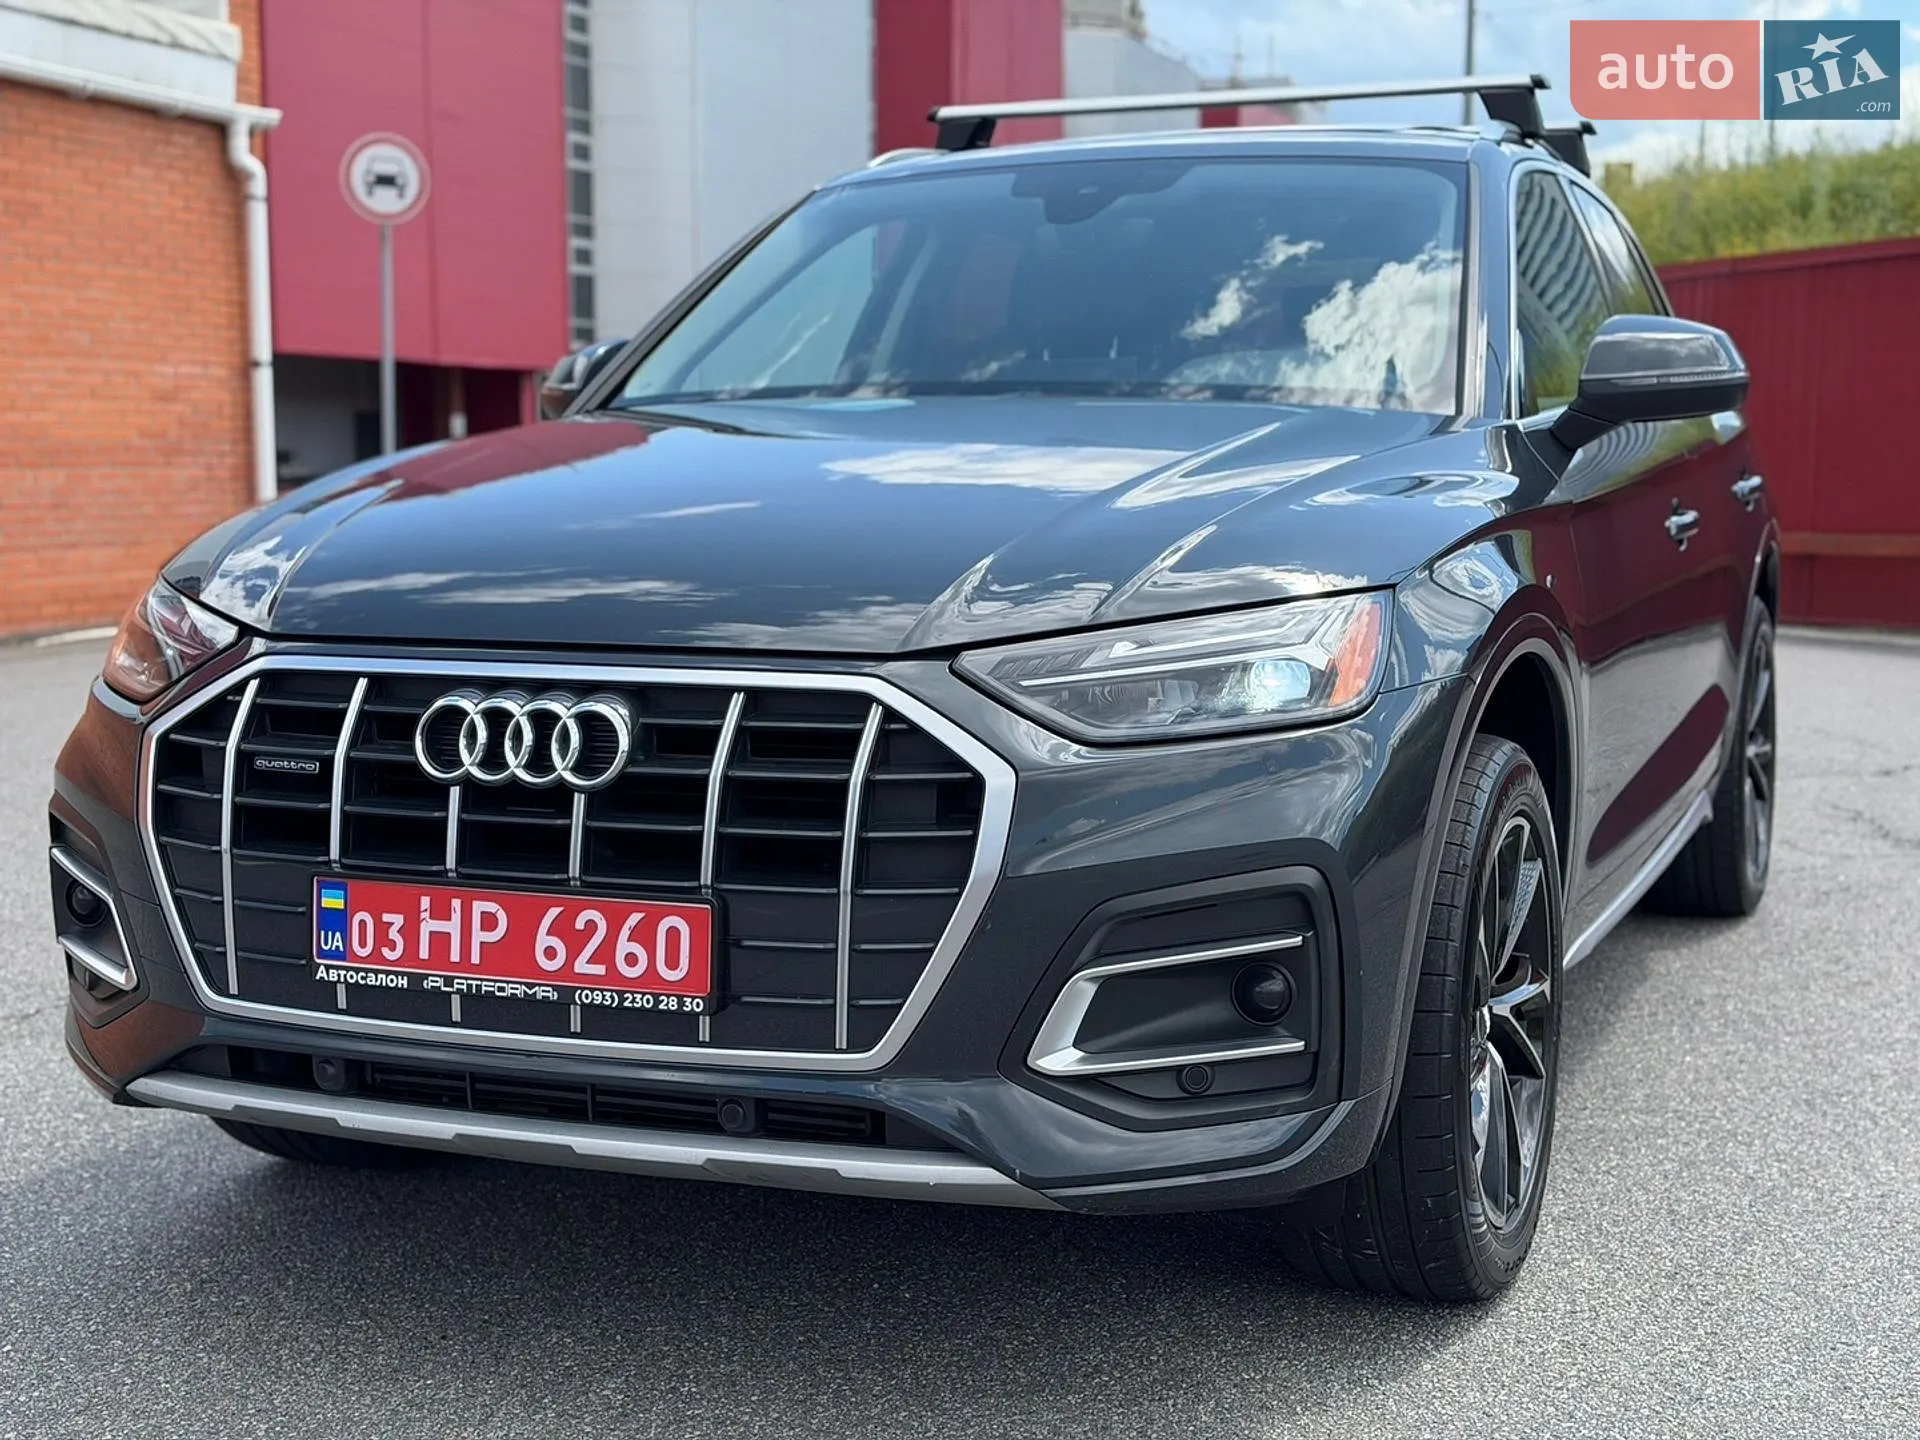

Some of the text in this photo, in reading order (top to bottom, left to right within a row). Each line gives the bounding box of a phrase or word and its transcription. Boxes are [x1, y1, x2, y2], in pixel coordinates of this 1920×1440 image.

[255, 759, 315, 771] quattro
[320, 930, 344, 952] UA
[350, 895, 691, 983] 03 HP 6260
[315, 965, 408, 989] Автосалон
[574, 989, 619, 1008] (093)
[623, 993, 654, 1008] 230
[658, 995, 678, 1010] 28
[682, 997, 704, 1012] 30
